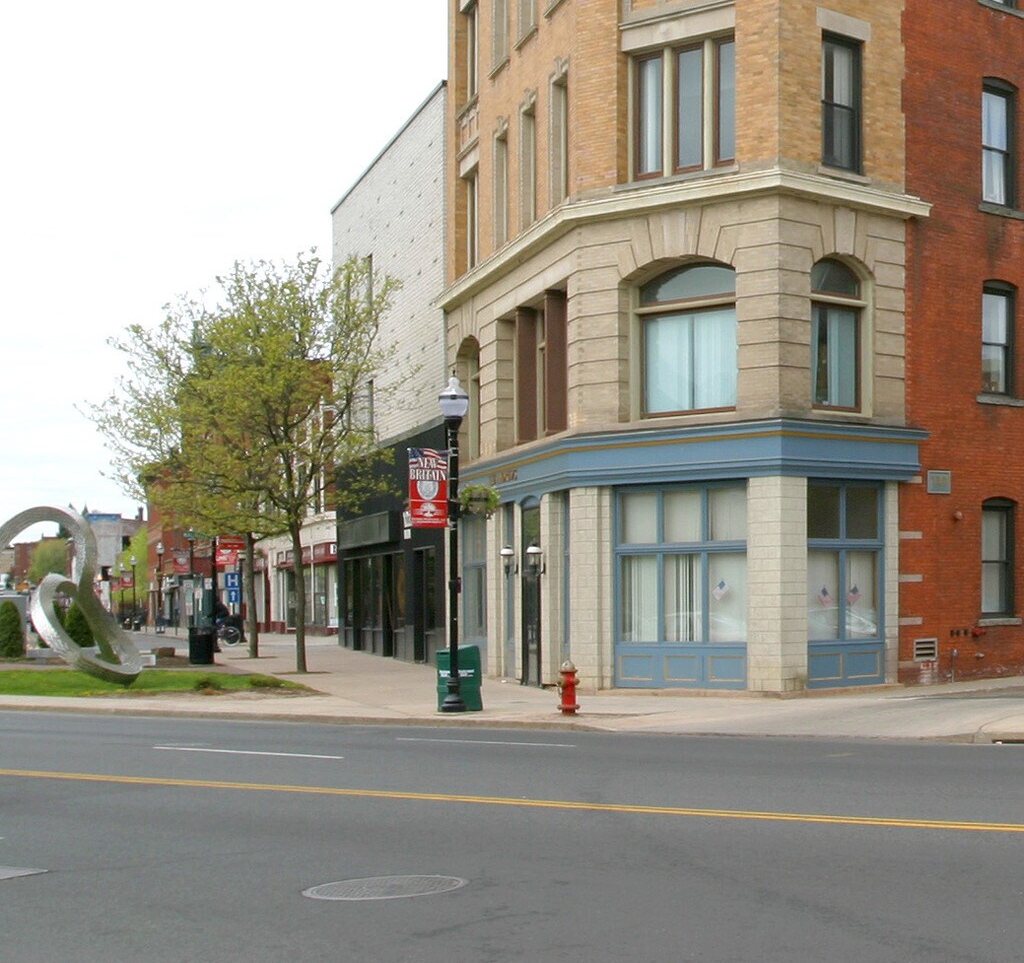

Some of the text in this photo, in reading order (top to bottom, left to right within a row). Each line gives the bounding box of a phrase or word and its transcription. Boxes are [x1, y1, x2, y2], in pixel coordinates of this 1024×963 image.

[418, 457, 437, 468] NEW
[409, 468, 446, 481] BRITAIN
[227, 575, 238, 586] H
